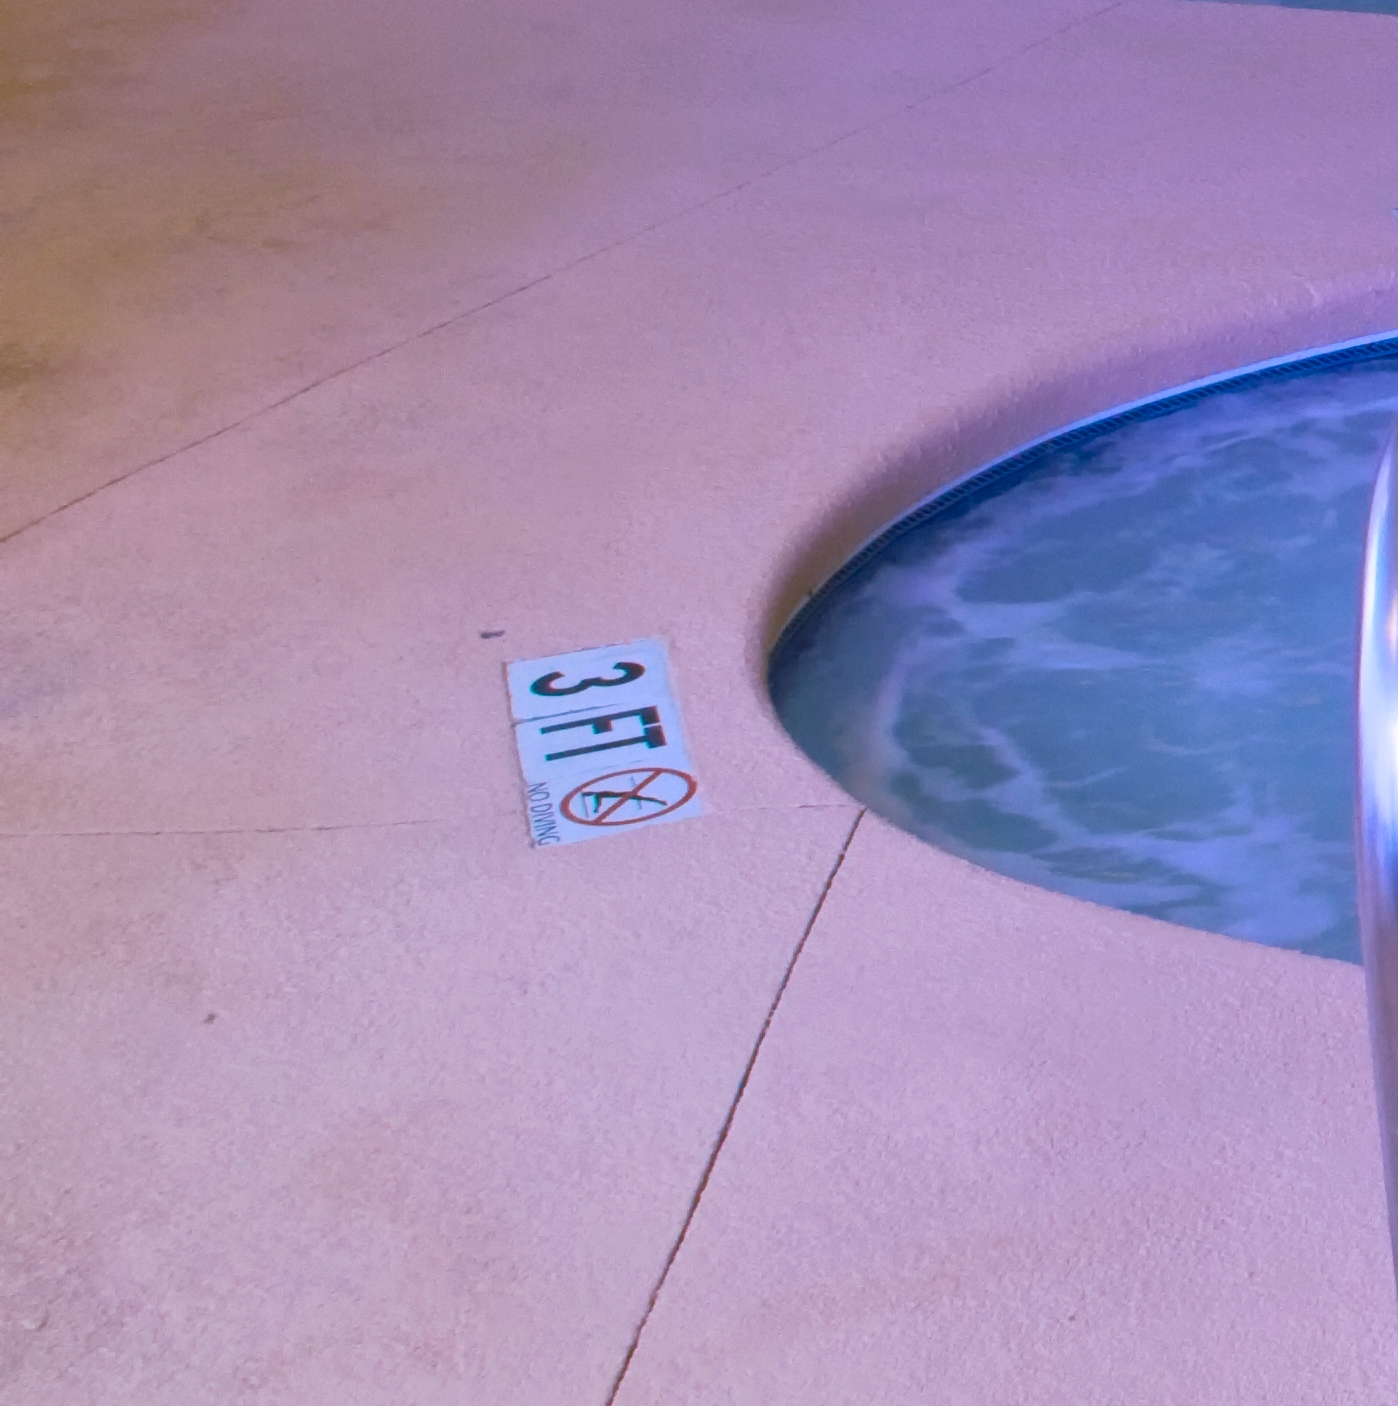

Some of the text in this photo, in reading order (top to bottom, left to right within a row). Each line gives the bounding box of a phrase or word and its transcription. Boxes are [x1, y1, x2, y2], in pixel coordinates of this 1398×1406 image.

[529, 661, 667, 762] 3 FT
[528, 782, 561, 846] NO DIVING
